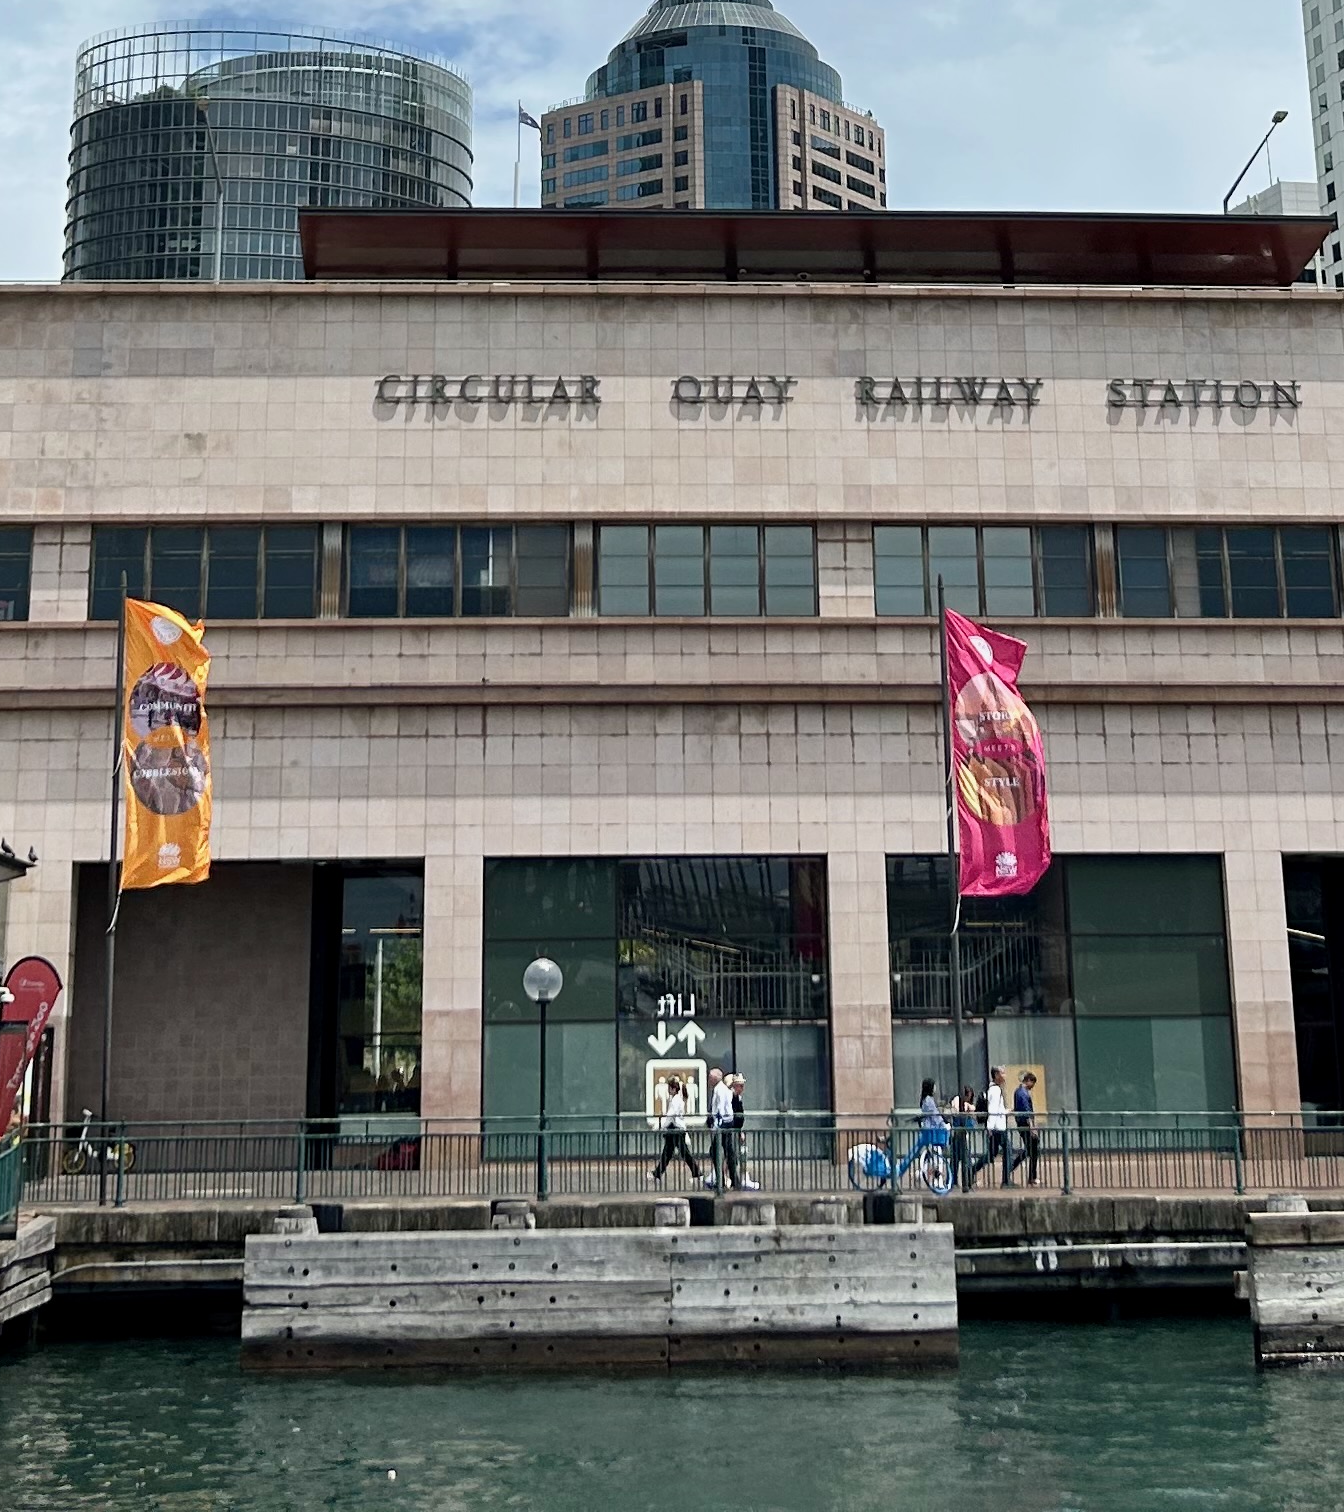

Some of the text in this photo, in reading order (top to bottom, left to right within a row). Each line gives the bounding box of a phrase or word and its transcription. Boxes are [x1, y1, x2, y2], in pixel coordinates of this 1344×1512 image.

[376, 374, 1302, 408] CIRCULAR QUAY RAILWAY STATION
[979, 710, 1016, 722] STOR
[983, 776, 1021, 787] STYLE
